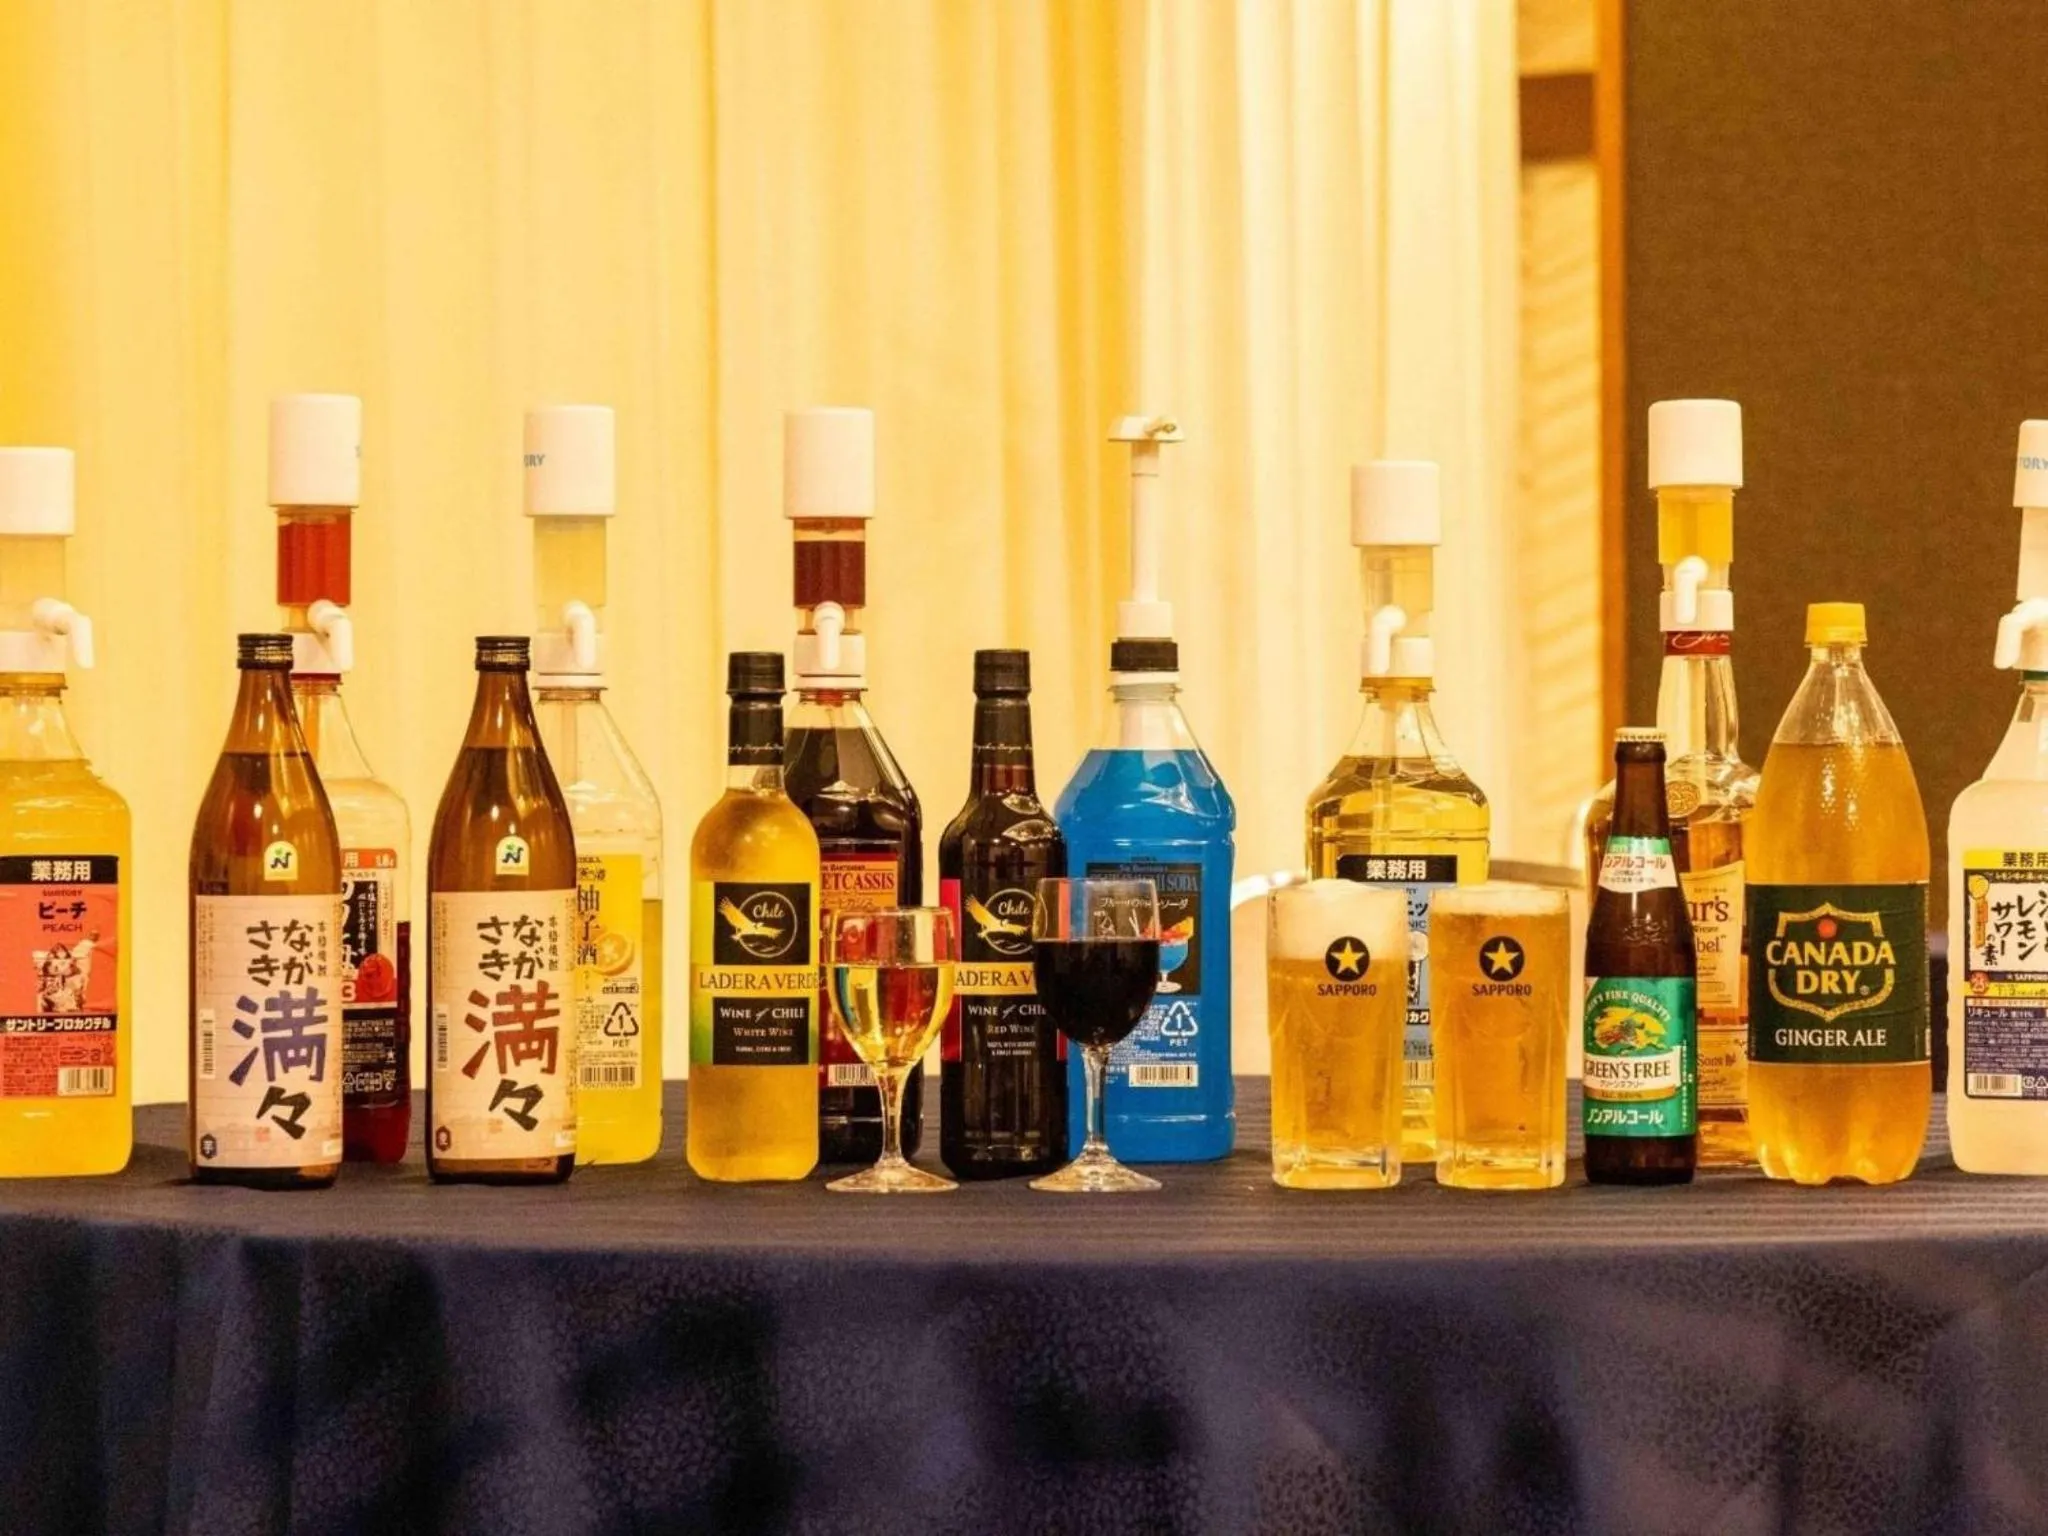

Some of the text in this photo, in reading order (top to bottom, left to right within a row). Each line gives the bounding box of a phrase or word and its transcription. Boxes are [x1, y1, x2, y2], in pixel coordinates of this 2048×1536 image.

[32, 860, 91, 881] 業務用
[1366, 859, 1427, 880] 業務用
[753, 902, 785, 918] Chile
[998, 900, 1030, 916] Chile
[42, 924, 82, 932] PEACH
[2017, 895, 2038, 961] レモン
[1766, 940, 1896, 966] CANADA
[1318, 984, 1377, 996] SAPPORO
[1472, 983, 1532, 996] SAPPORO
[1796, 970, 1861, 994] DRY
[720, 1007, 752, 1018] WINE
[968, 1005, 998, 1016] WINE
[987, 1024, 1007, 1034] RED
[1169, 1038, 1188, 1047] PET
[1775, 1028, 1887, 1047] GINGER ALE
[1634, 1060, 1672, 1078] FREE
[1587, 1108, 1664, 1125] ノンアルコール
